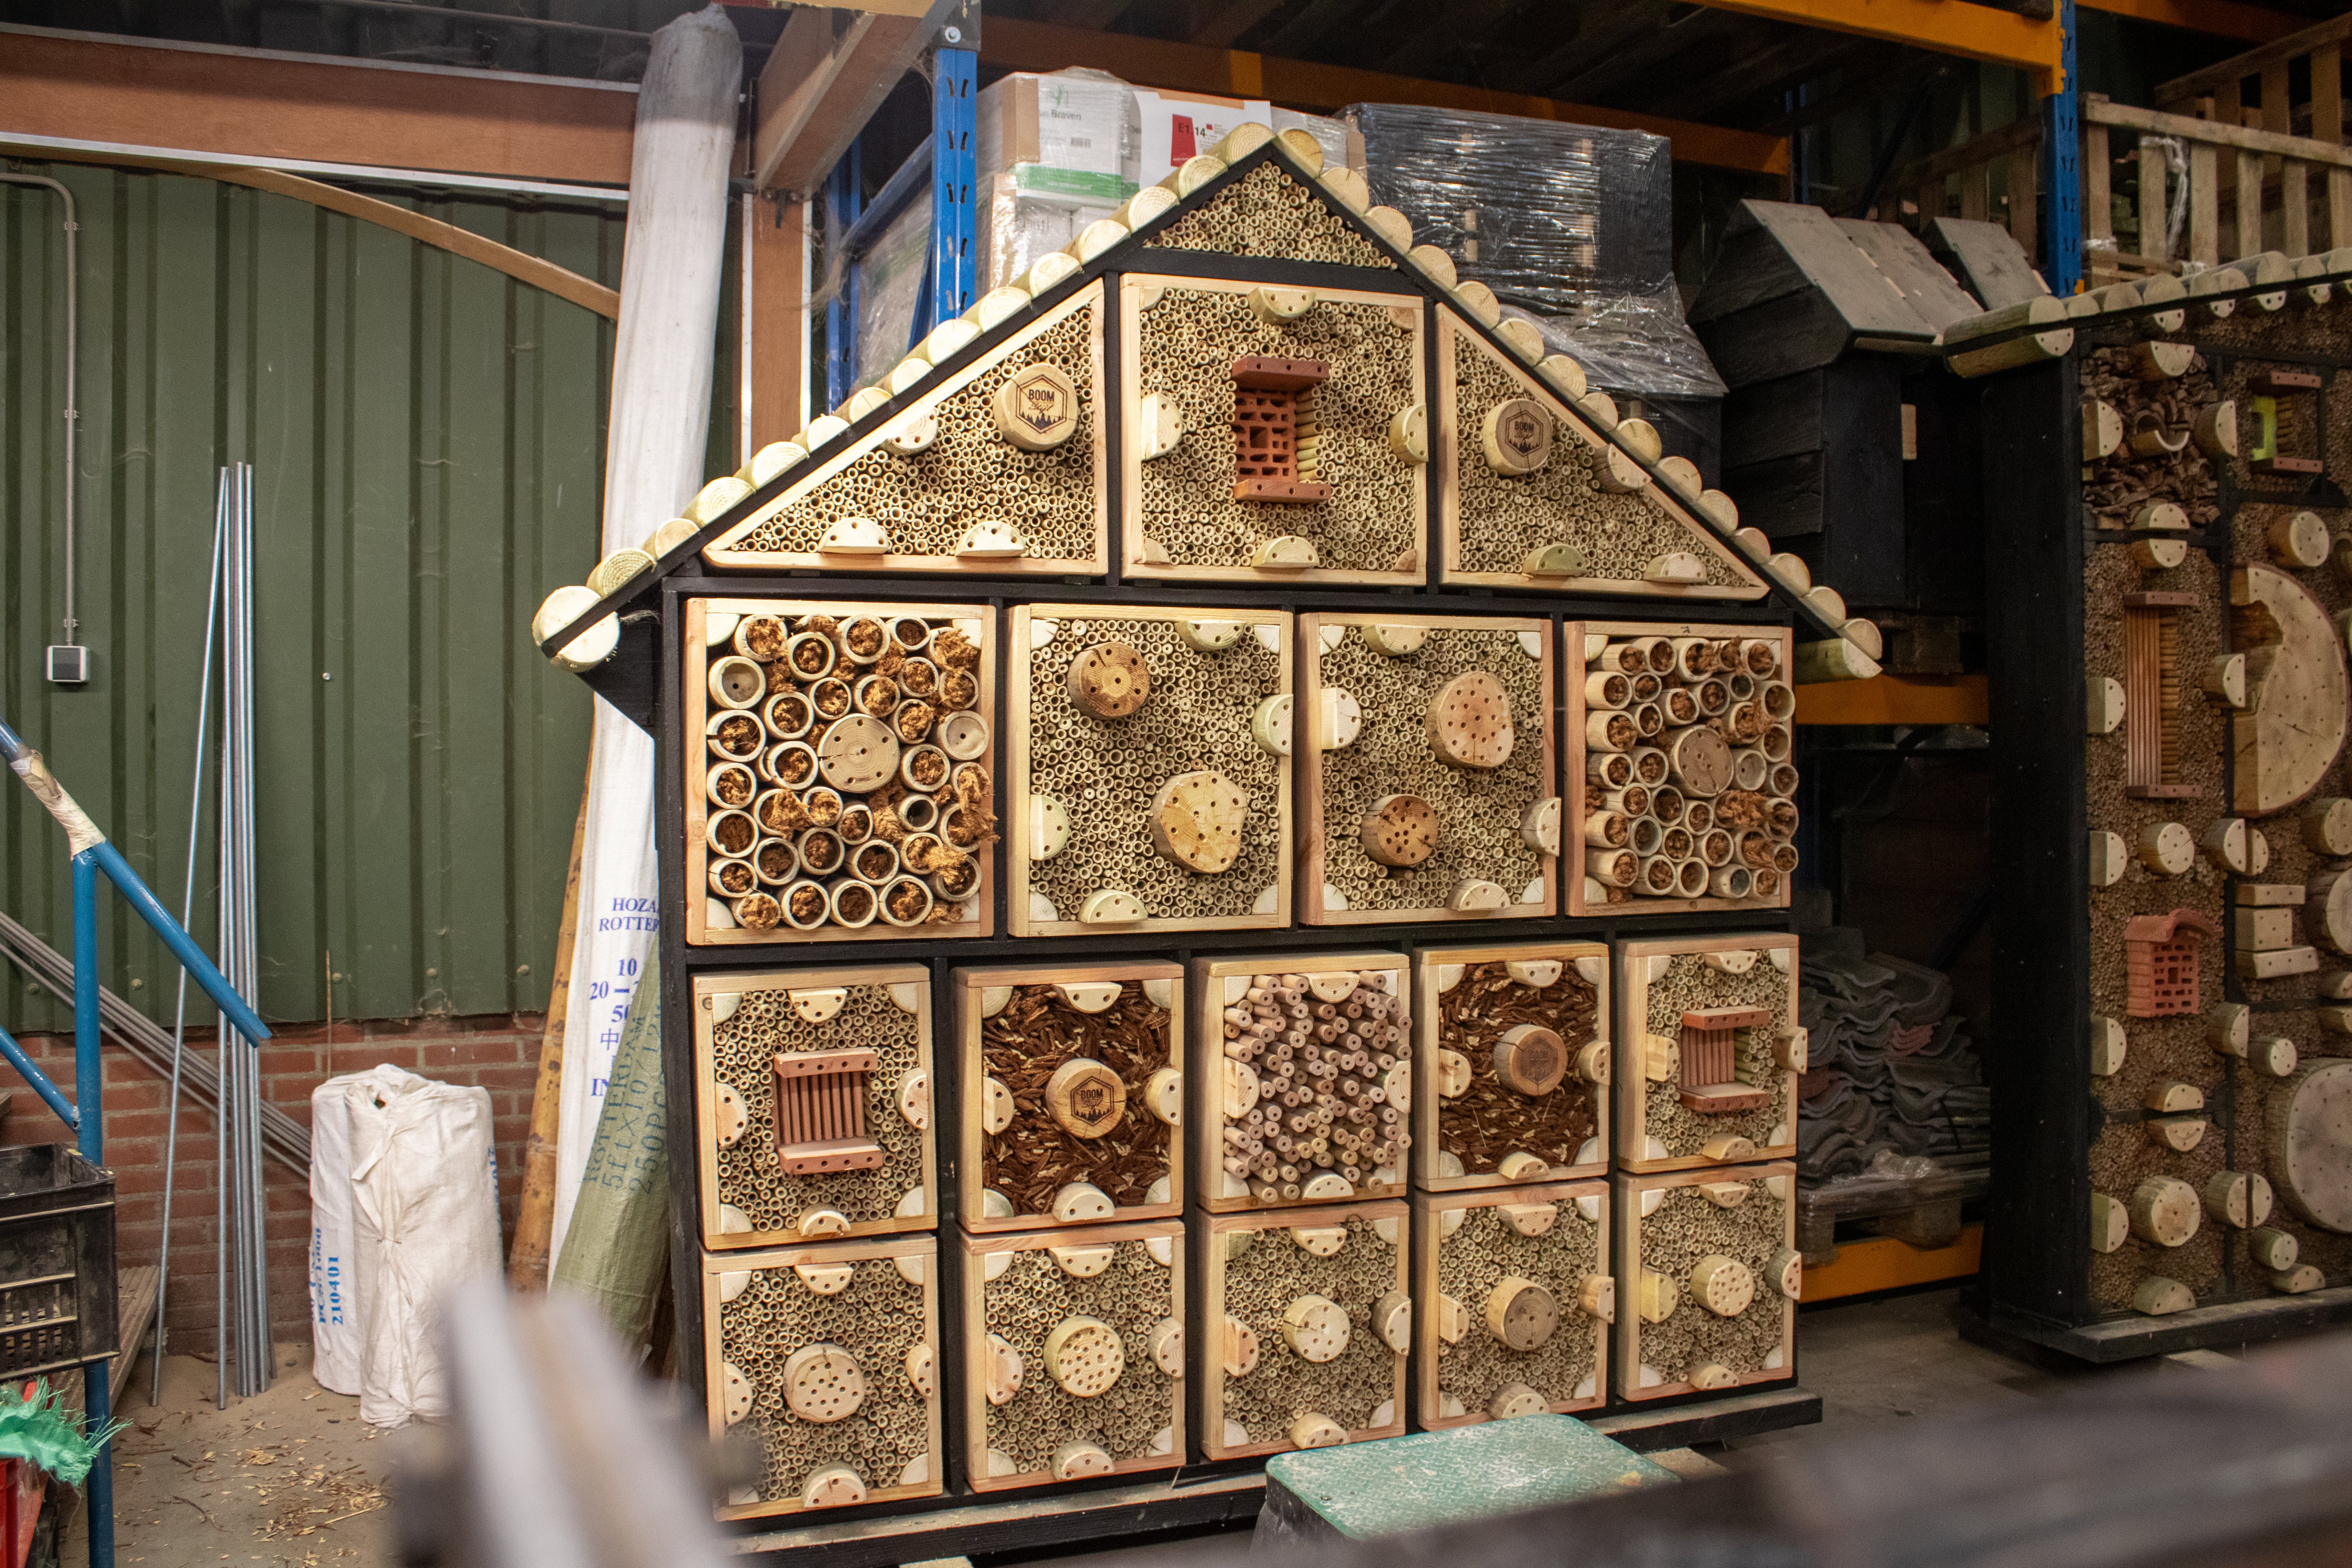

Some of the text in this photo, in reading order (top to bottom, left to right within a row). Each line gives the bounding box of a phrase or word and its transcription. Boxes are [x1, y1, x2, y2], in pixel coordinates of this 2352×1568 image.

[1051, 109, 1082, 120] Braven
[1029, 389, 1055, 402] BOOM
[1515, 421, 1534, 432] BOOM
[612, 898, 659, 913] HOZA
[618, 958, 637, 976] 10
[582, 1016, 646, 1183] ROTTERDAM
[1081, 1089, 1103, 1099] BOOM
[328, 1257, 343, 1325] 210401
